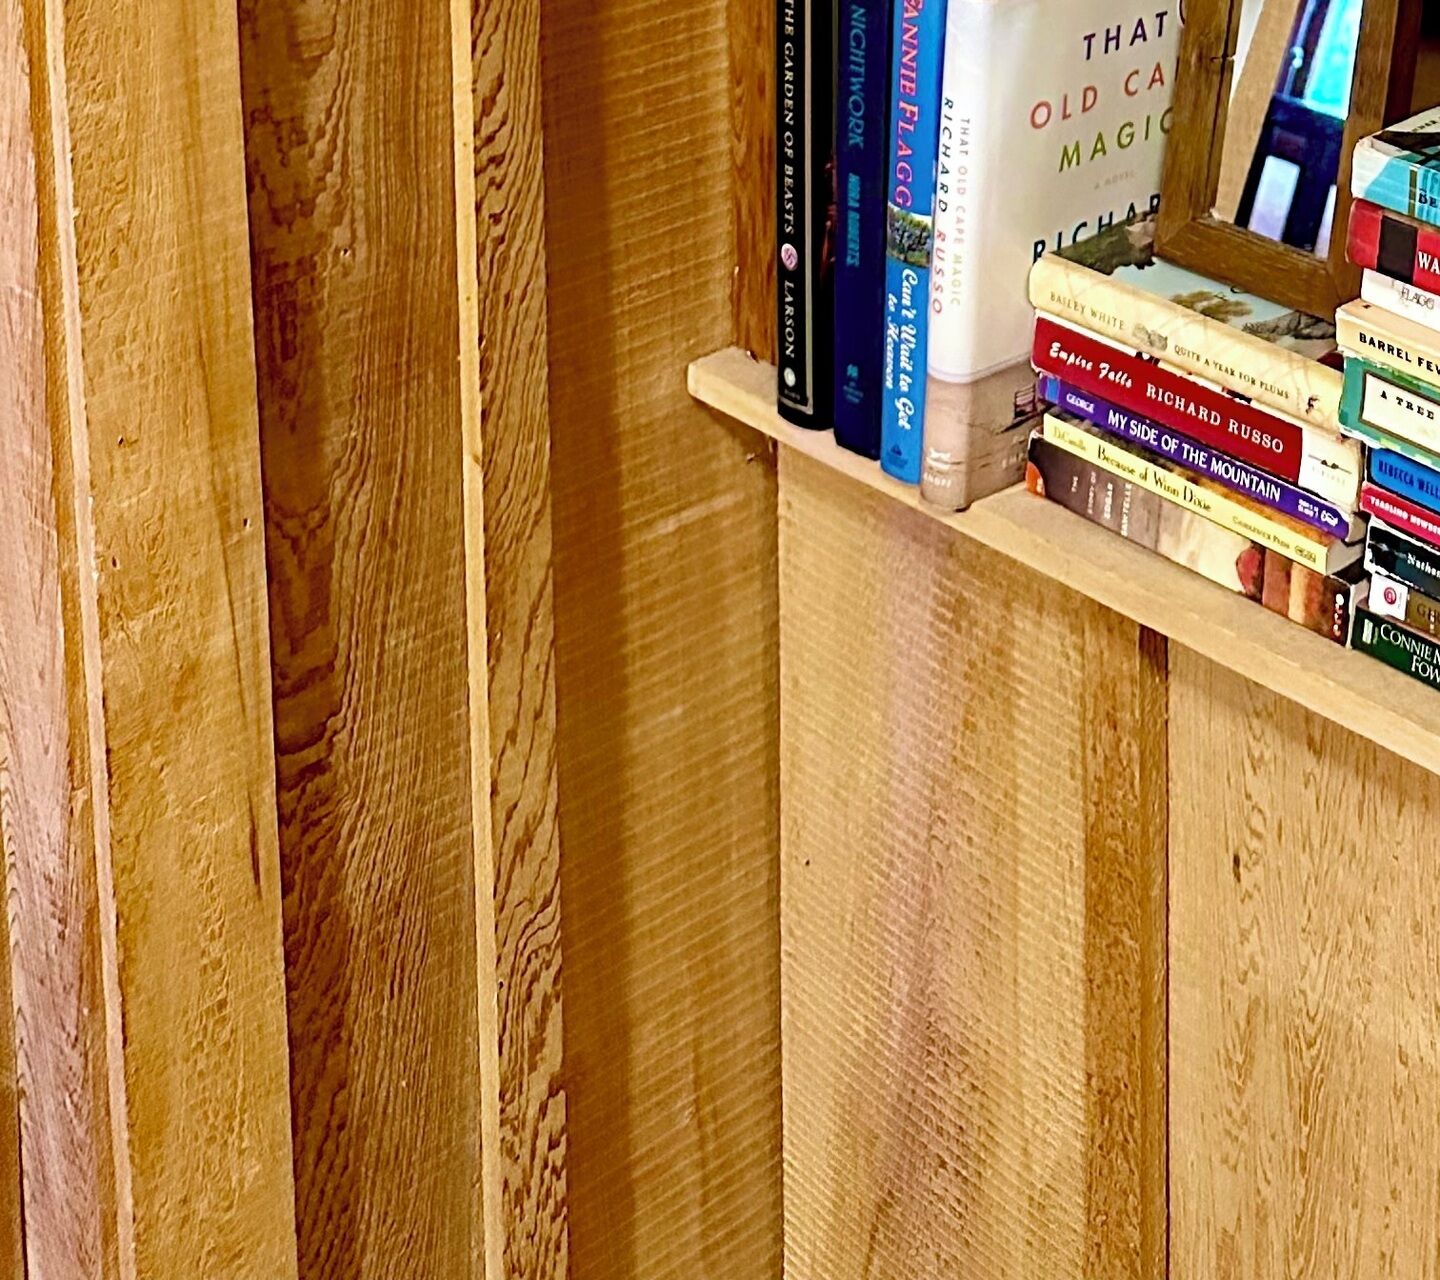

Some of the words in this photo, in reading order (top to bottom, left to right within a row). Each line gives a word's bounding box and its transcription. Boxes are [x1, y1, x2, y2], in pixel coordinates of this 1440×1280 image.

[1083, 9, 1169, 61] THAT
[783, 41, 794, 126] GARDEN
[848, 3, 868, 150] NIGHTWORK
[783, 131, 794, 158] OF
[894, 100, 920, 209] FLAGG
[937, 96, 955, 214] RICHARD
[783, 167, 795, 235] BEASTS
[900, 267, 919, 322] Can't
[932, 231, 947, 315] RUSSO
[783, 279, 796, 359] LARSON
[898, 323, 917, 372] Wait
[1358, 330, 1413, 362] BARREL
[894, 395, 916, 431] Get
[898, 374, 914, 393] to
[1380, 390, 1389, 401] A
[1395, 396, 1436, 421] TREE
[1146, 381, 1222, 427] RICHARD
[1227, 420, 1285, 455] RUSSO
[1108, 407, 1129, 431] MY
[1129, 418, 1160, 447] SIDE
[1160, 433, 1180, 455] OF
[1181, 442, 1209, 470] THE
[1209, 455, 1282, 503] MOUNTAIN
[1380, 622, 1433, 661] CONNIE
